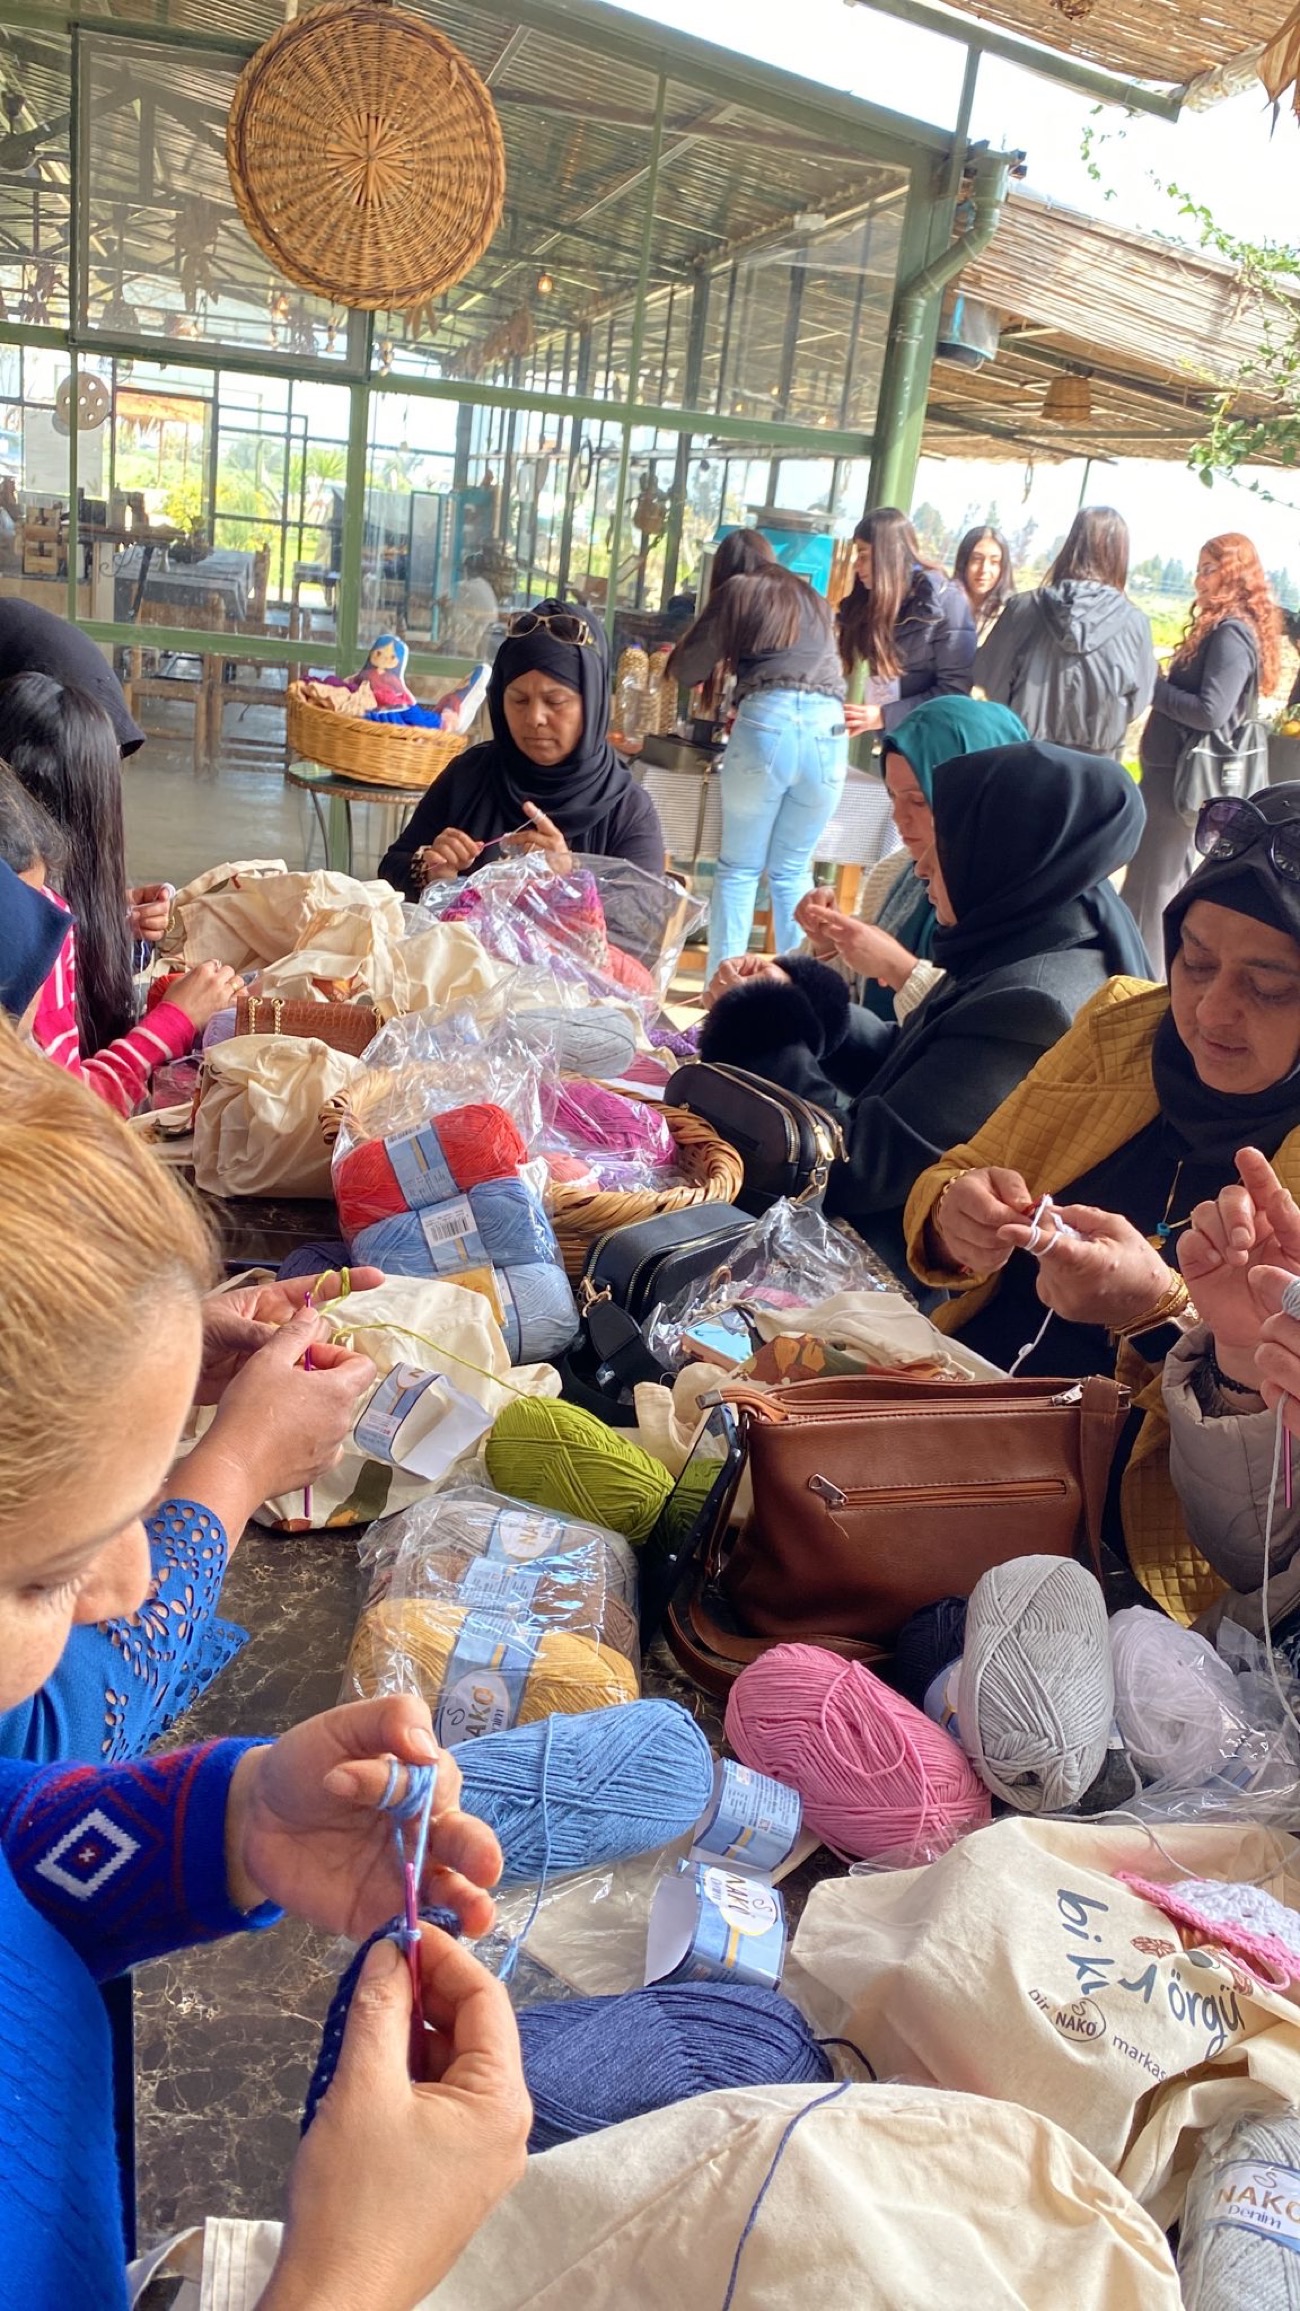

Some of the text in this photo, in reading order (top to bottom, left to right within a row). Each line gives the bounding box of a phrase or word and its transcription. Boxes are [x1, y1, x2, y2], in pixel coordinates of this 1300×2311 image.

[463, 1687, 494, 1741] AKO
[1057, 1888, 1109, 1943] bi
[1167, 1968, 1246, 2060] örgü
[1055, 2012, 1096, 2036] NAKO
[1113, 2036, 1168, 2081] markas
[1228, 2204, 1281, 2229] Denim
